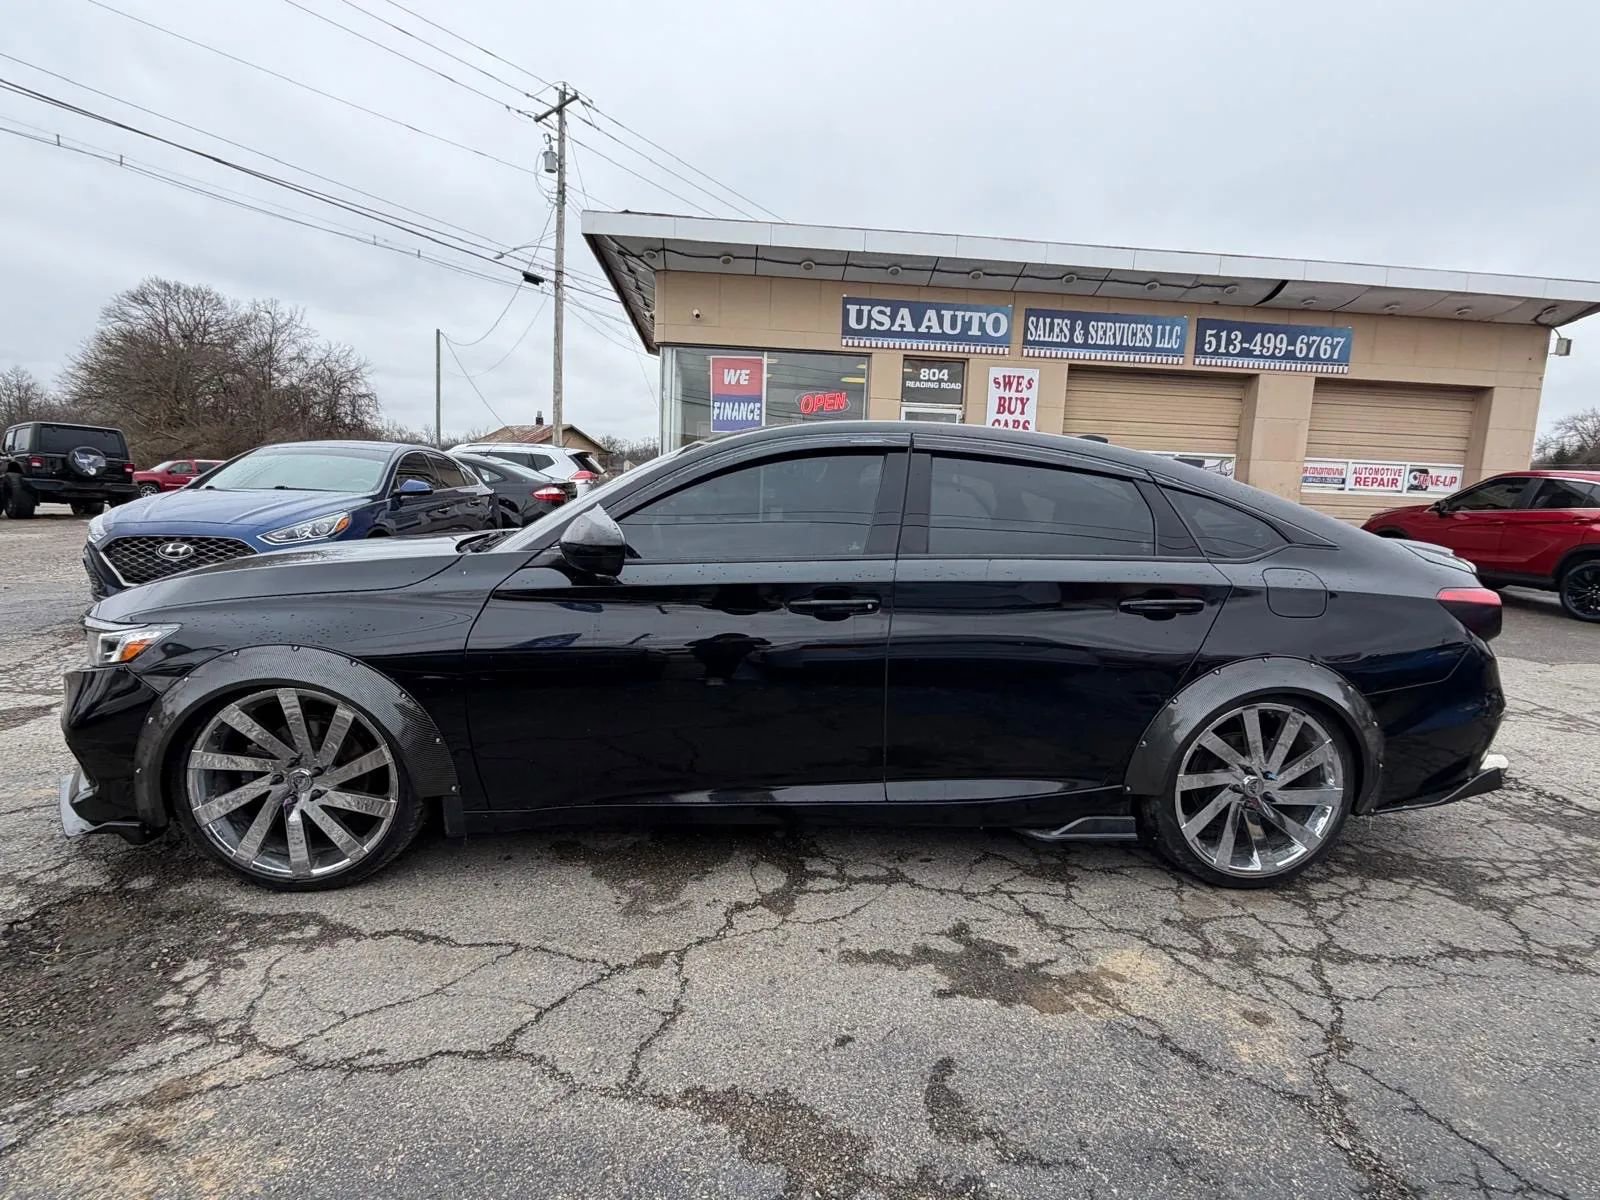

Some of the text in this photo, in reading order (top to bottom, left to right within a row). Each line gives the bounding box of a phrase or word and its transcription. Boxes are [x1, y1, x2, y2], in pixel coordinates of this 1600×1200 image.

[846, 304, 1009, 338] USA AUTO
[1027, 316, 1182, 350] SALES & SERVICES LLC
[1204, 329, 1346, 360] 513-499-6767
[723, 368, 750, 385] WE
[919, 368, 949, 381] 804
[905, 380, 962, 390] READING ROAD
[713, 401, 761, 421] FINANCE
[800, 392, 847, 415] OPEN
[996, 395, 1030, 415] BUY
[1352, 466, 1403, 477] AUTOMOTIVE
[1354, 476, 1399, 488] REPAIR
